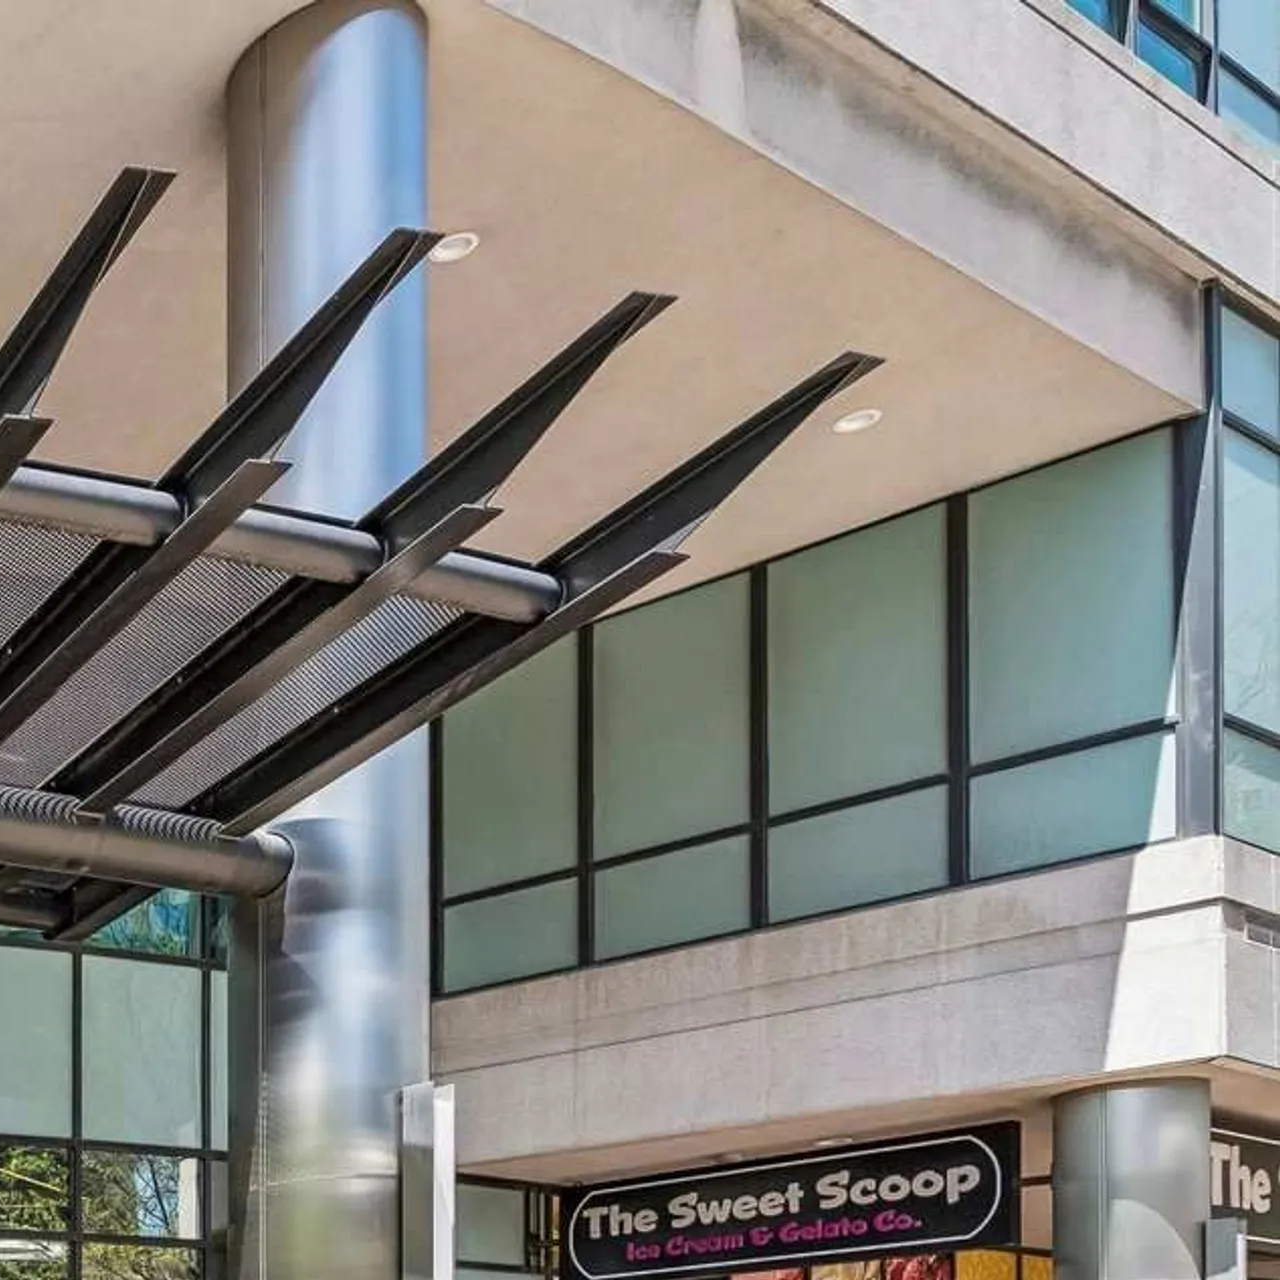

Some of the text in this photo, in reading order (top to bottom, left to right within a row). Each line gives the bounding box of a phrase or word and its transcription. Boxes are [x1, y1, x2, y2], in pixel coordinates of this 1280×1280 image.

[581, 1162, 981, 1240] The Sweet Scoop
[1209, 1141, 1272, 1214] The
[625, 1207, 923, 1262] Ice Cream & Gelato Co.
